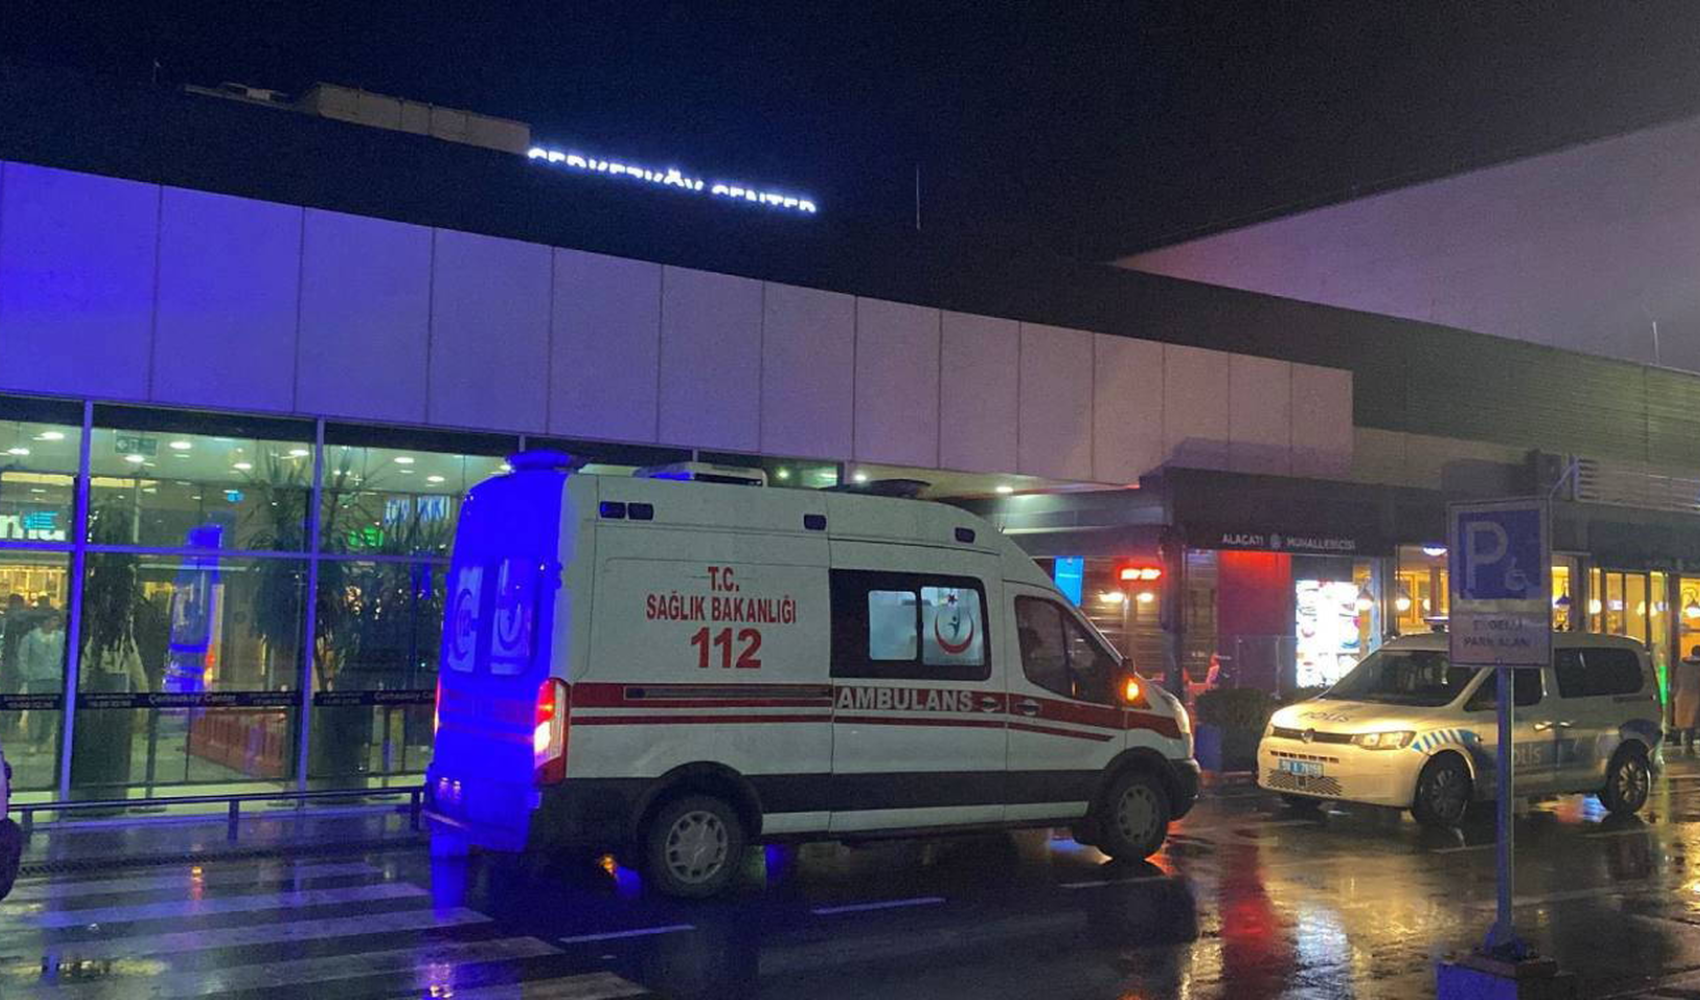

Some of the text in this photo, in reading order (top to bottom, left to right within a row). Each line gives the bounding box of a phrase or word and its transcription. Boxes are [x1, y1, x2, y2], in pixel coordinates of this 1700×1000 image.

[1466, 521, 1508, 590] P
[708, 566, 739, 591] T.C.
[646, 591, 796, 623] SAĞLIK BAKANLIĞI
[691, 627, 761, 668] 112
[837, 687, 973, 712] AMBULANS
